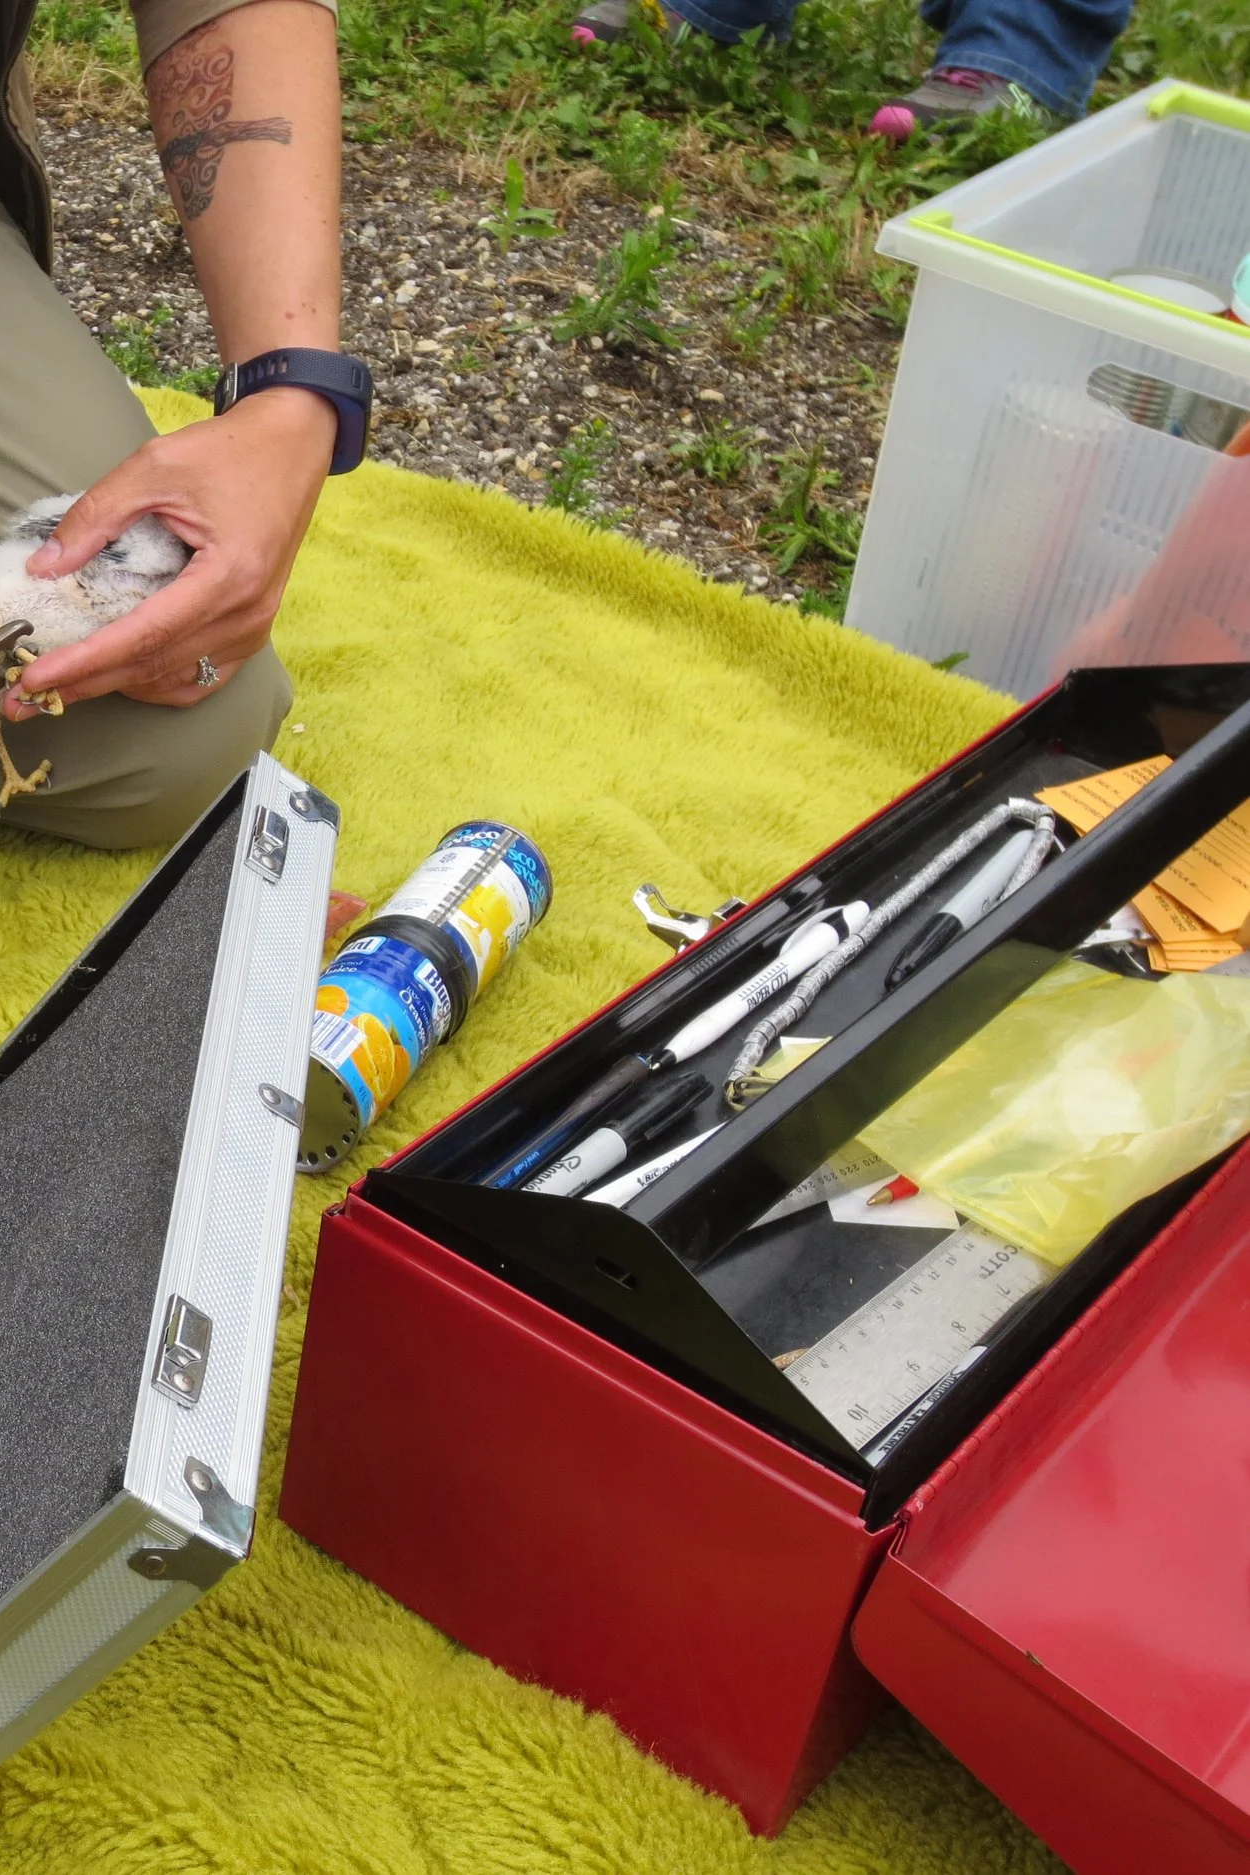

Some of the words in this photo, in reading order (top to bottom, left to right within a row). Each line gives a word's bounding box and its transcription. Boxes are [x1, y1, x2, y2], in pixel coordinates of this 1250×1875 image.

[746, 984, 771, 1012] PAPER
[771, 968, 790, 992] CITY
[399, 989, 427, 1046] Orange
[862, 1154, 882, 1167] 210
[644, 1168, 660, 1183] BIC
[839, 1163, 860, 1176] 220
[817, 1172, 838, 1185] 230
[963, 1241, 975, 1252] 14
[946, 1256, 957, 1266] 13
[979, 1243, 1020, 1277] COTT
[928, 1270, 940, 1281] 12
[910, 1285, 922, 1296] 11
[996, 1283, 1011, 1296] 7
[892, 1300, 904, 1310] 10
[951, 1320, 967, 1333] 8
[906, 1359, 921, 1372] 9
[800, 1376, 810, 1386] 5
[847, 1403, 869, 1422] 10
